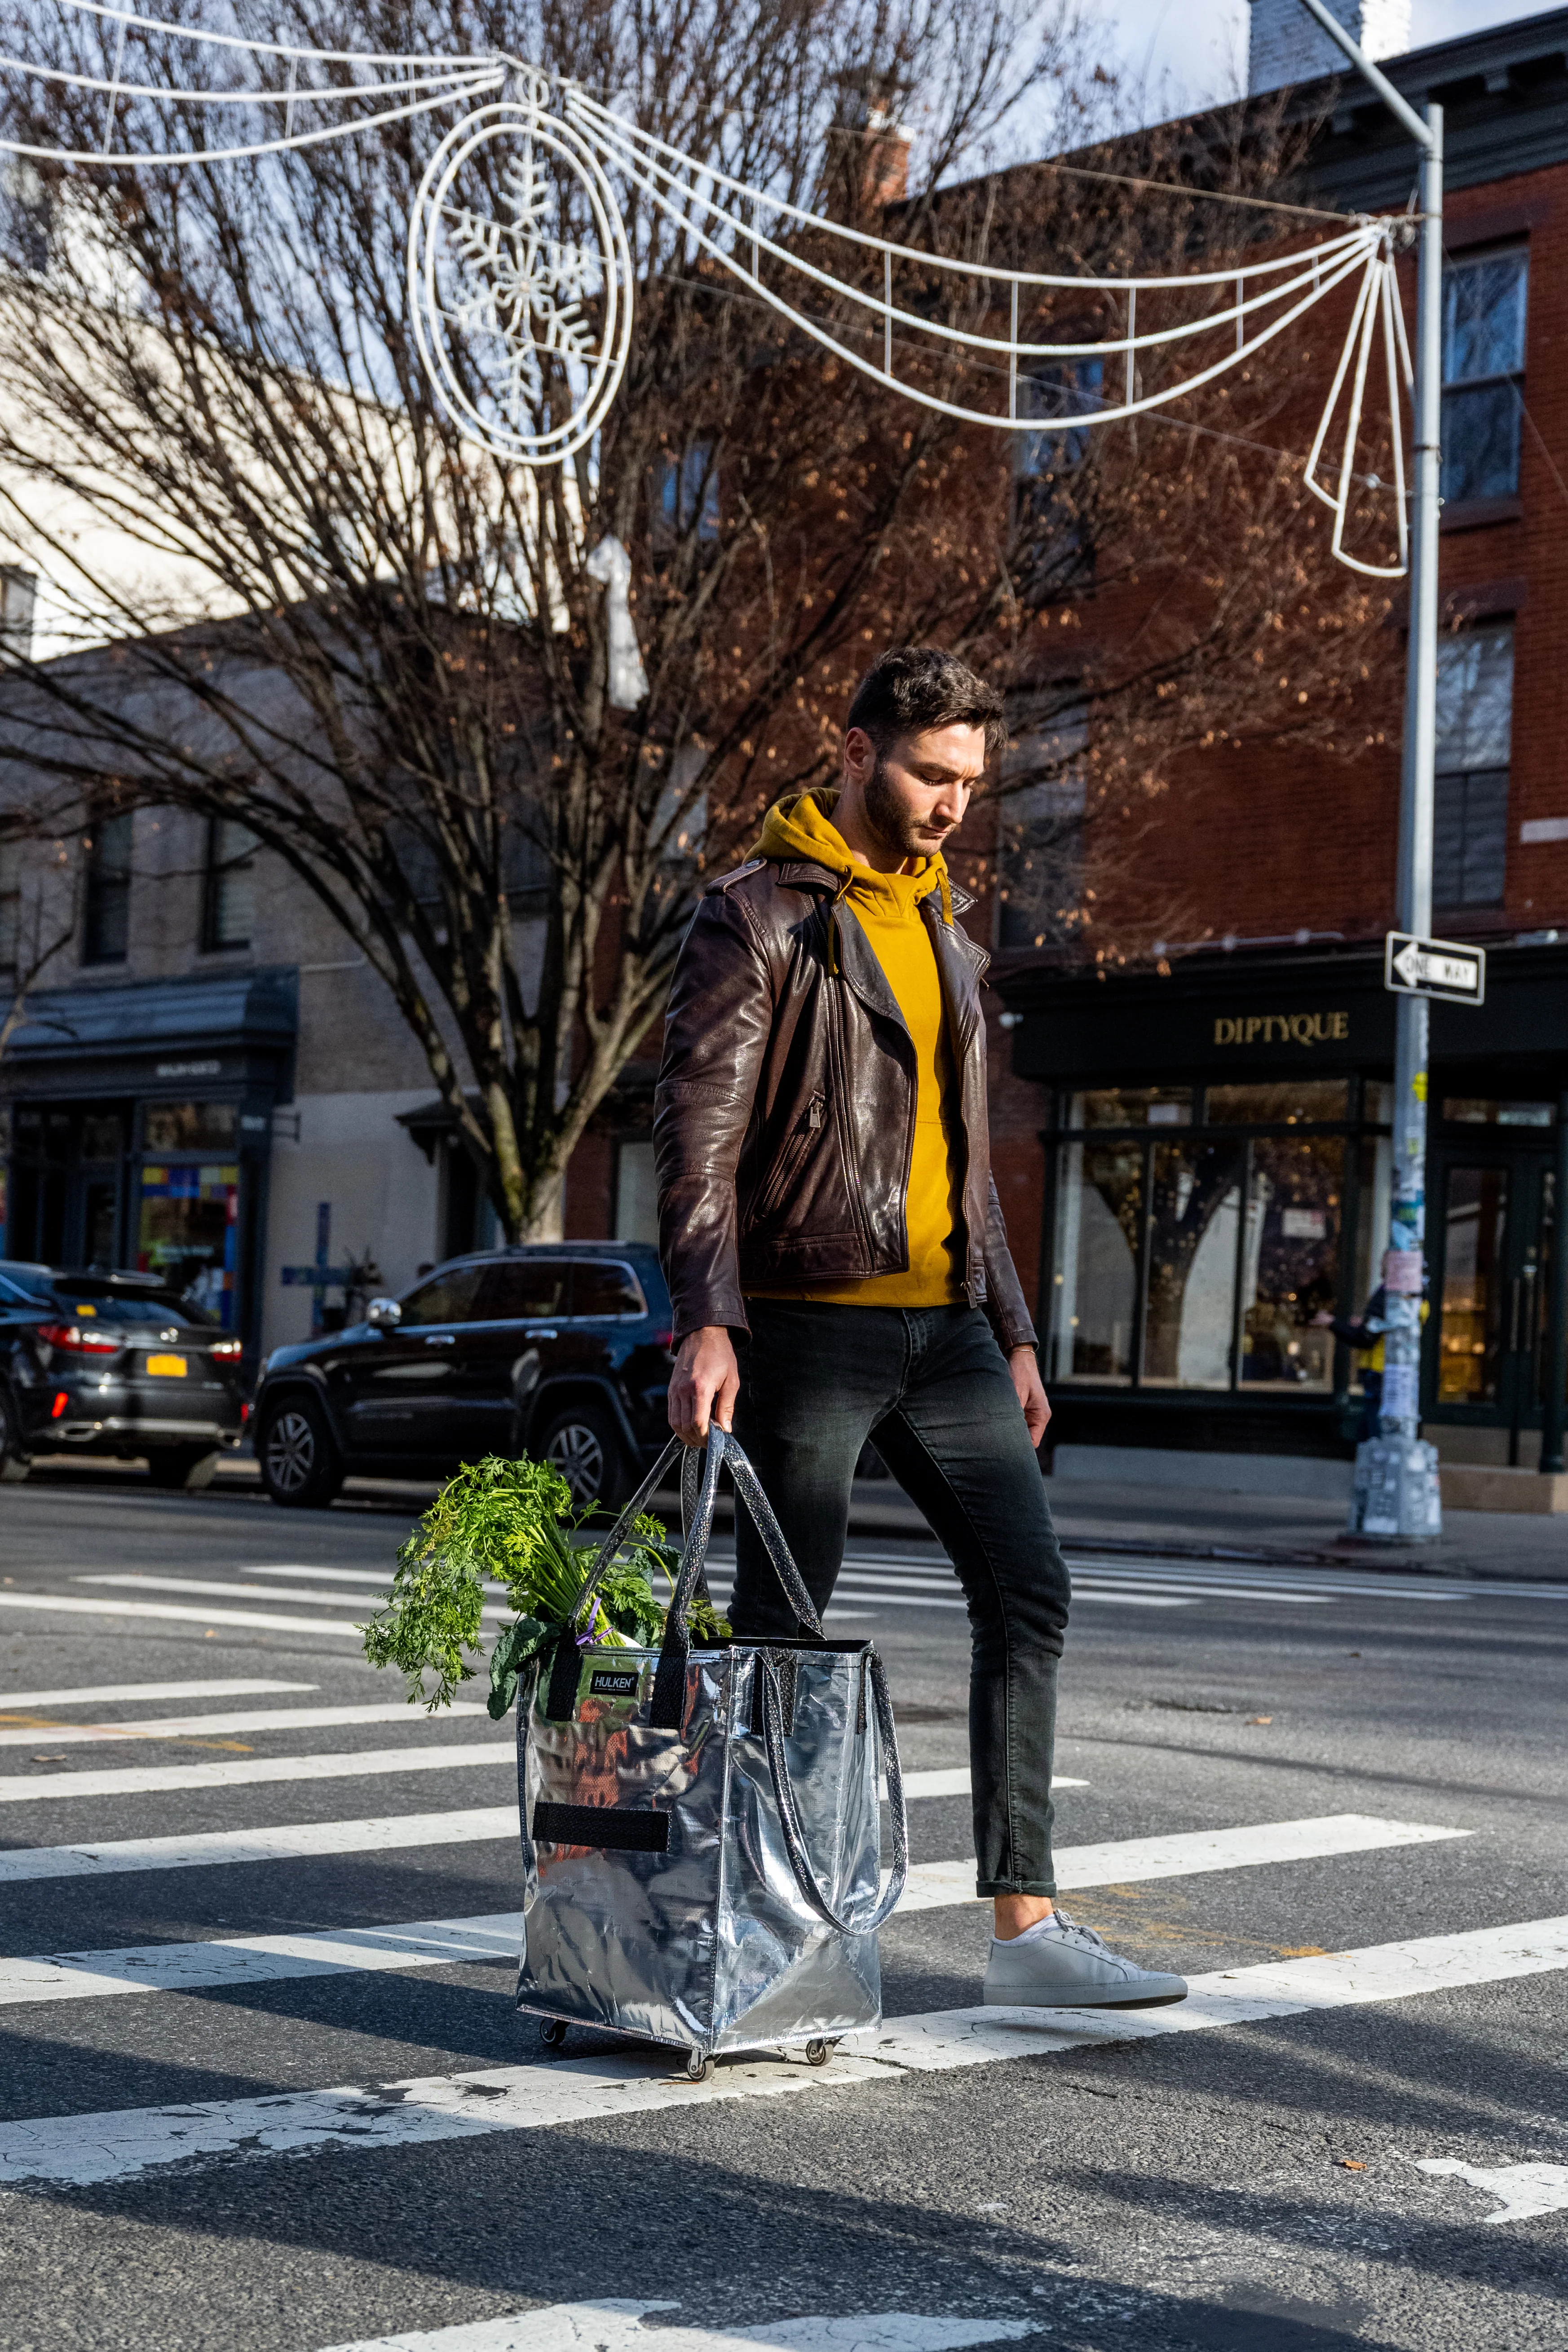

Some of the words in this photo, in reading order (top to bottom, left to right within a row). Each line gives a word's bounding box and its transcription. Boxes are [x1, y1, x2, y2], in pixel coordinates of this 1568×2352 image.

[1405, 955, 1430, 976] ONE
[1444, 963, 1471, 981] WAY
[1214, 1012, 1348, 1046] DIPTYQUE
